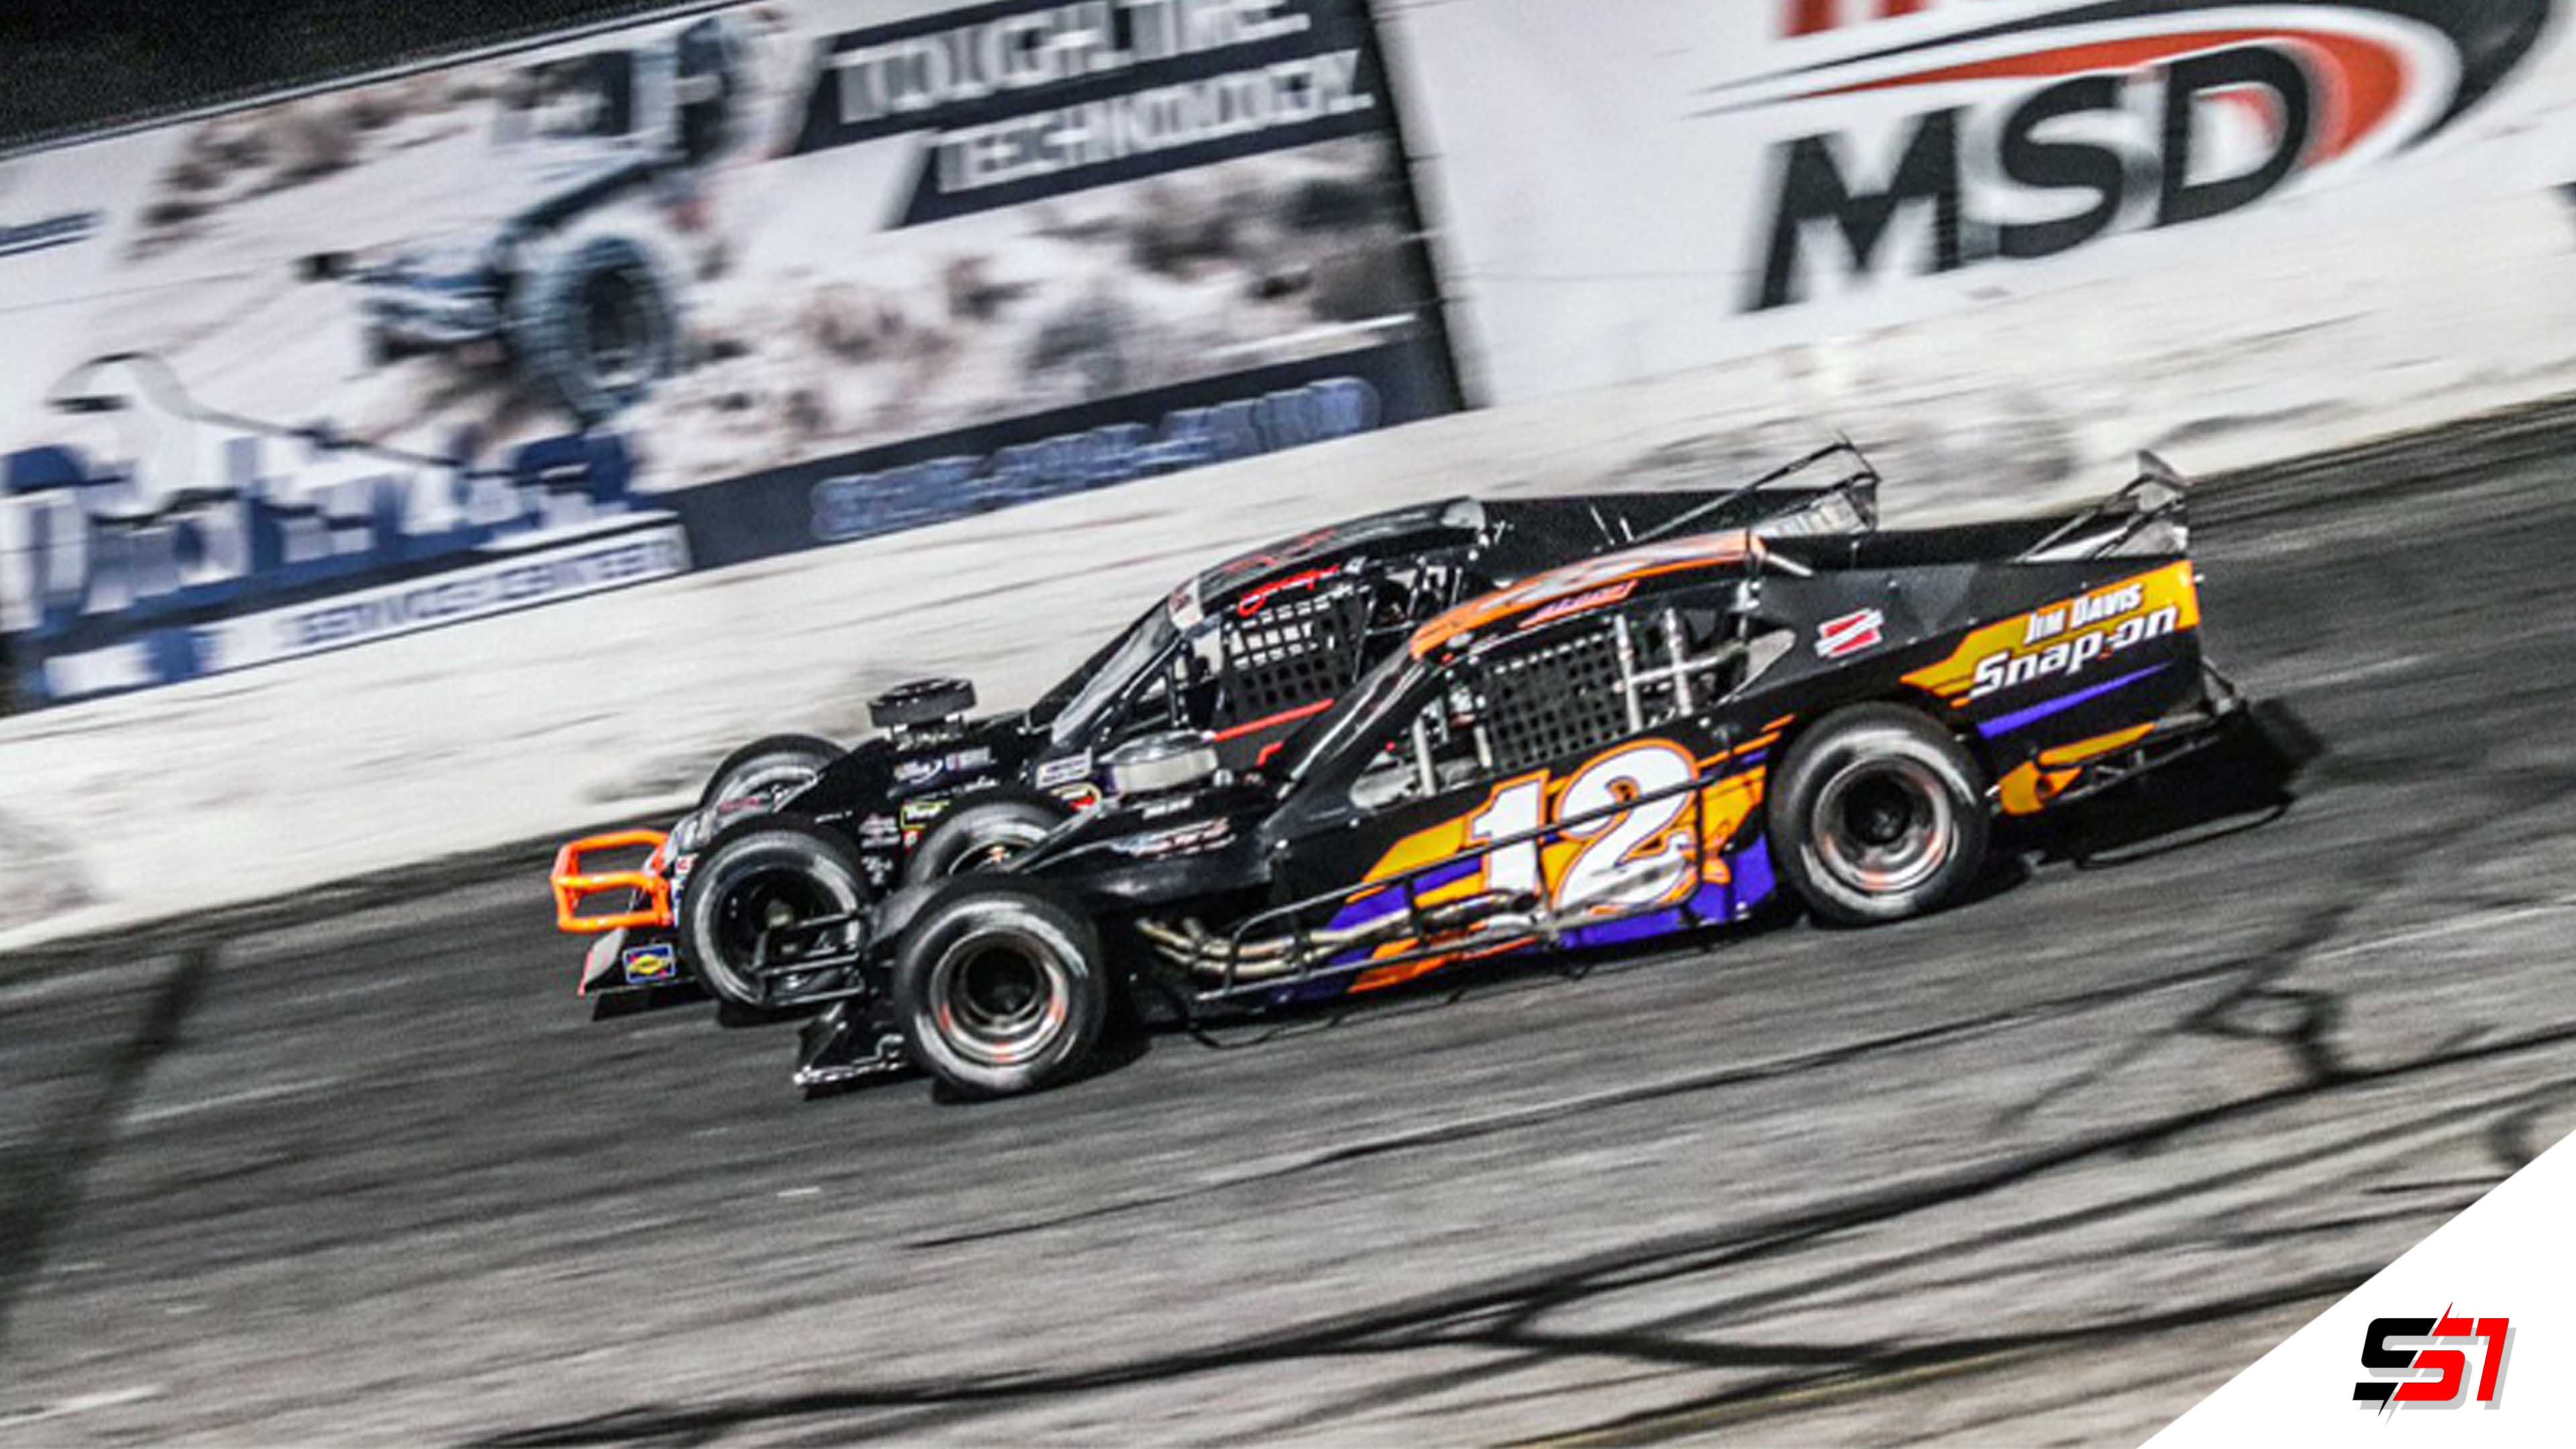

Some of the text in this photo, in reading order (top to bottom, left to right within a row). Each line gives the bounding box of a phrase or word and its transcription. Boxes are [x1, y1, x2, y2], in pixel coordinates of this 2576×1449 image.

[1743, 45, 2314, 311] MSD
[1970, 606, 2176, 698] Snap-on
[1467, 737, 1698, 914] 12
